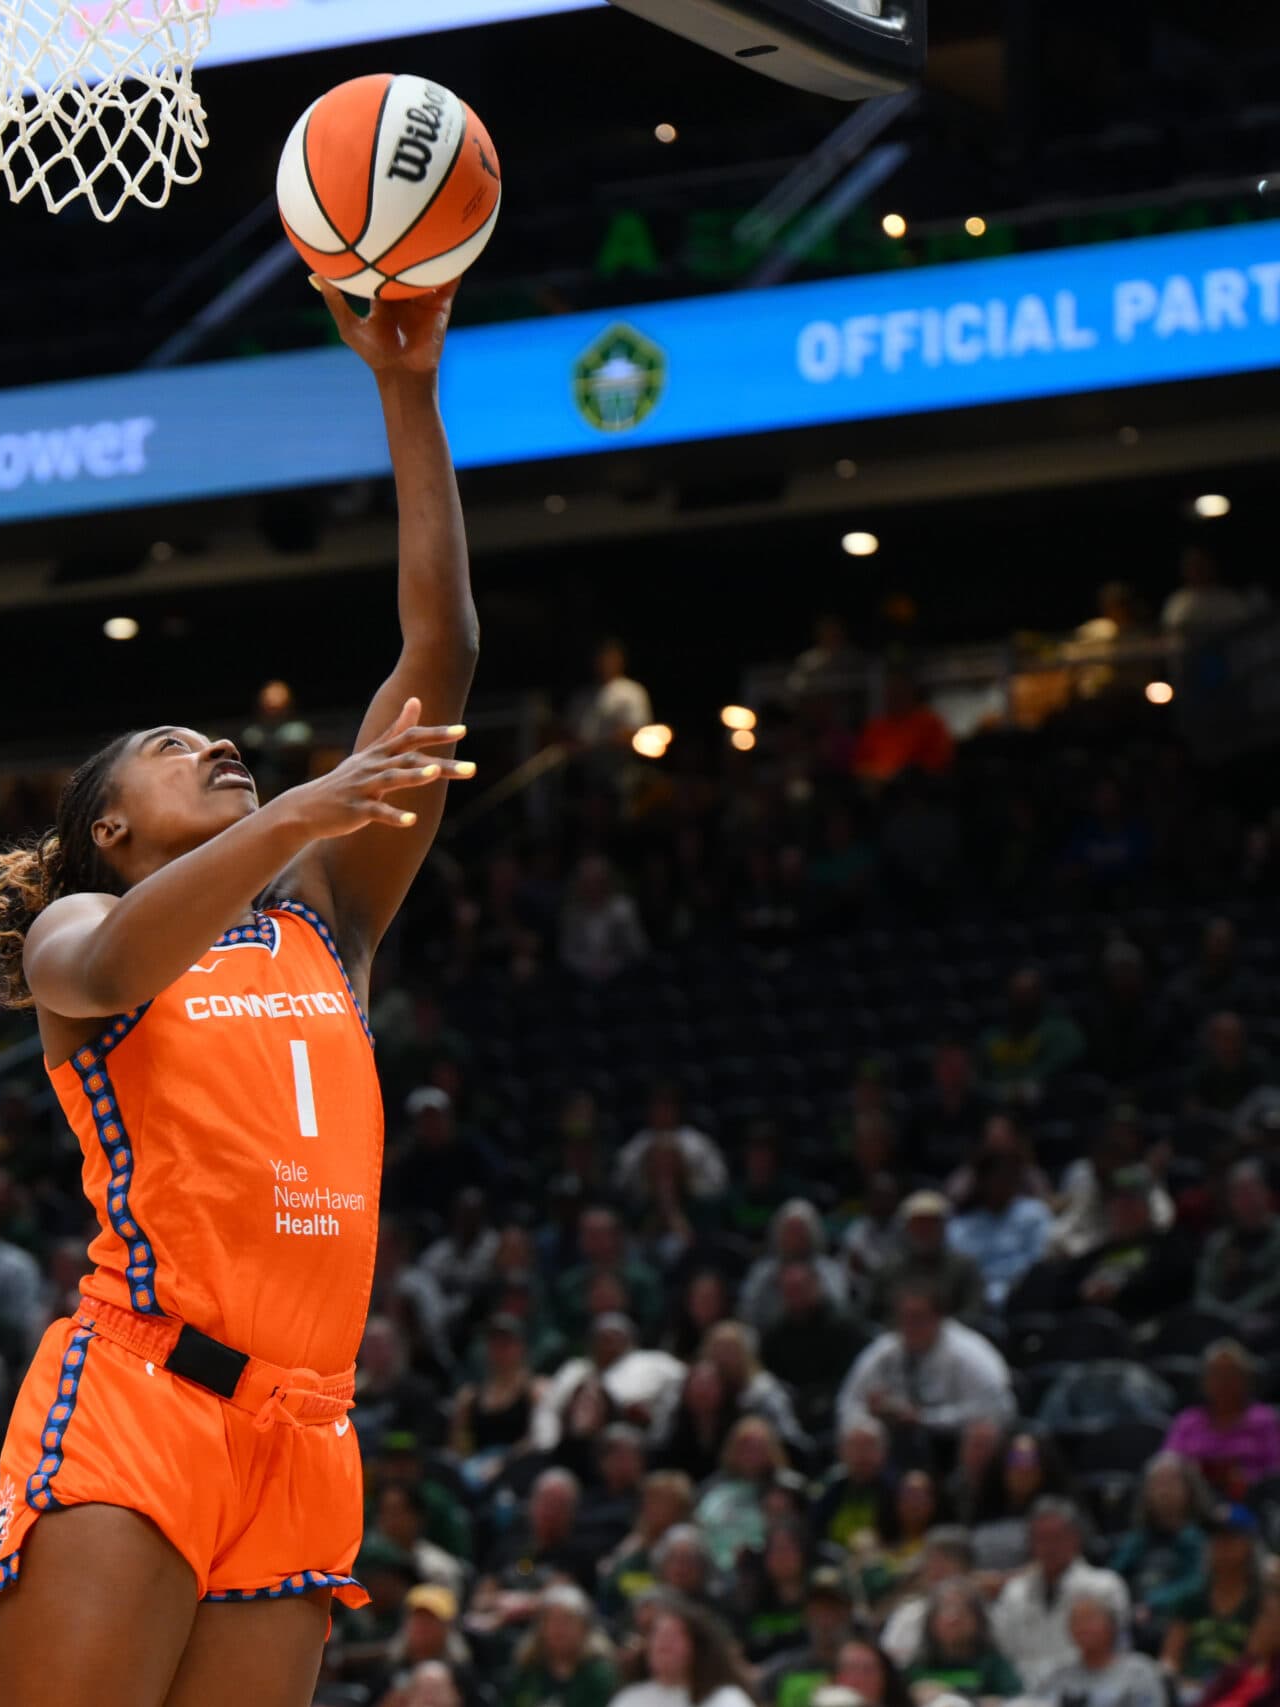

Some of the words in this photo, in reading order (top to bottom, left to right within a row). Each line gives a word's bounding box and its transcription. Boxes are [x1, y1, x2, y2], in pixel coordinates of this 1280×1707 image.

[387, 86, 446, 182] Wilso
[796, 290, 1097, 383] OFFICIAL
[185, 992, 349, 1020] CONNECTICU
[290, 1040, 318, 1137] 1
[269, 1160, 308, 1182] Yale
[276, 1212, 339, 1236] Health
